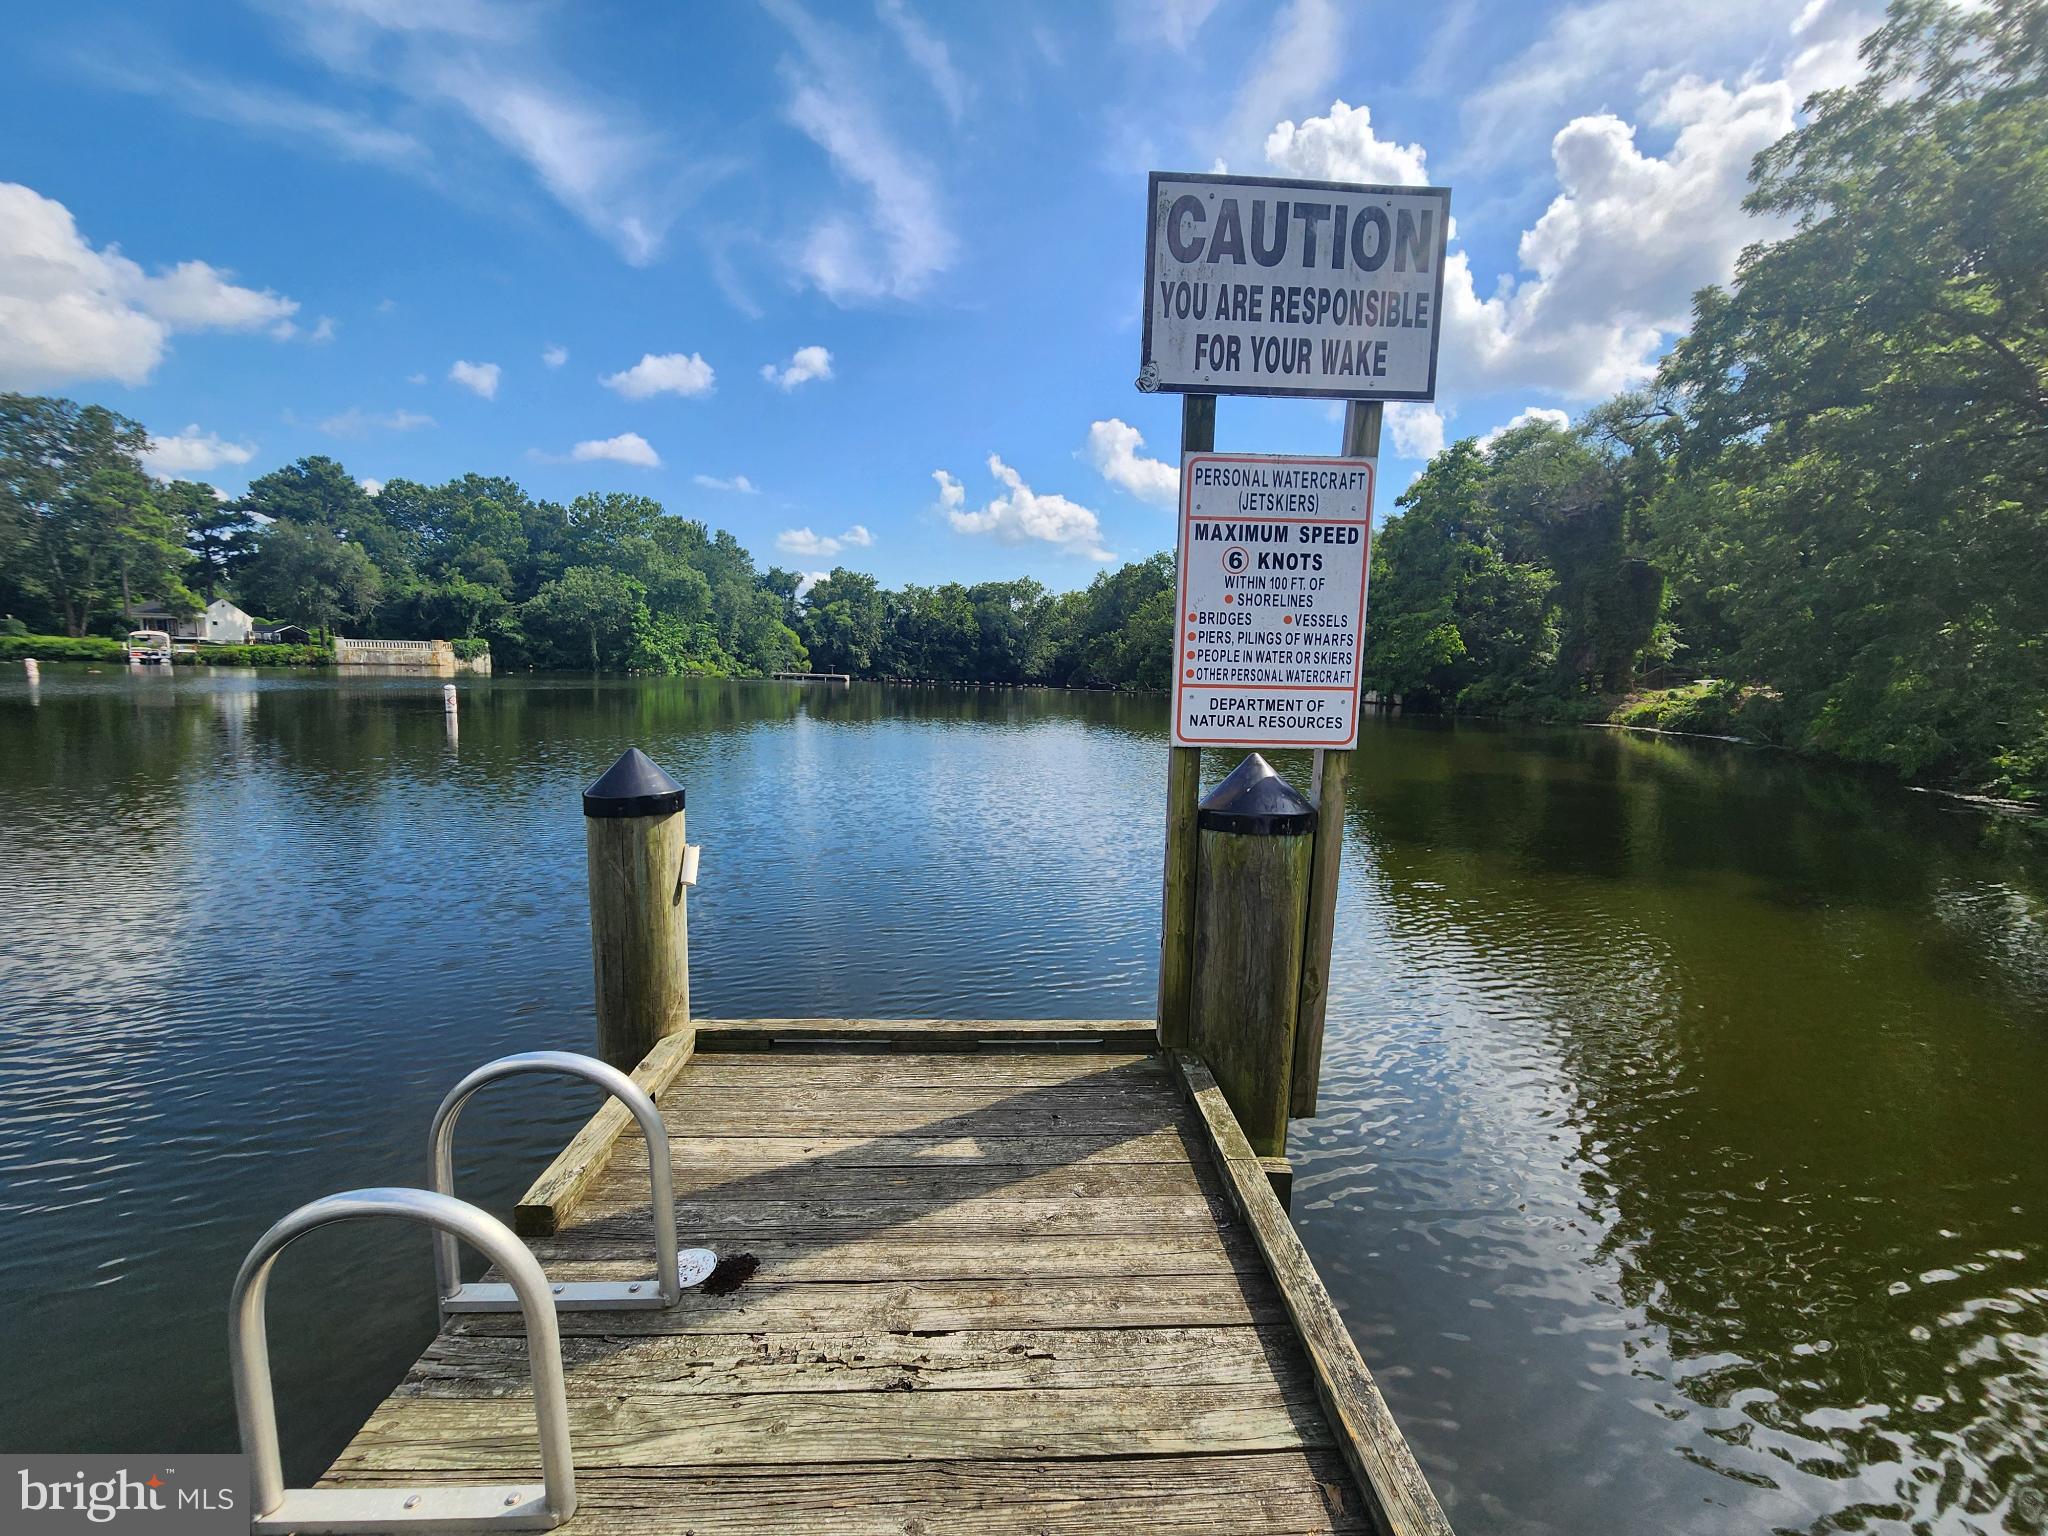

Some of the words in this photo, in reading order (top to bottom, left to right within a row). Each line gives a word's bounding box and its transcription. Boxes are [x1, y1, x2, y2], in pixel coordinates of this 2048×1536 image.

[1167, 195, 1433, 273] CAUTION
[1161, 281, 1208, 320] YOU
[1215, 284, 1263, 322] ARE
[1270, 286, 1429, 328] RESPONSIBLE
[1195, 334, 1241, 372] FOR
[1251, 336, 1312, 374] YOUR
[1321, 339, 1388, 376] WAKE
[1195, 468, 1269, 487] PERSONAL
[1273, 470, 1365, 490] WATERCRAFT
[1238, 491, 1319, 515] (JETSKIERS)
[1194, 523, 1288, 543] MAXIMUM
[1299, 525, 1359, 545] SPEED
[1228, 551, 1243, 570] 6
[1257, 552, 1323, 571] KNOTS
[1224, 575, 1266, 590] WITHIN
[1269, 576, 1288, 590] 100
[1290, 577, 1306, 591] FT.
[1309, 577, 1325, 591] OF
[1237, 593, 1313, 608] SHORELINES
[1198, 612, 1252, 626] BRIDGES
[1295, 613, 1348, 628] VESSELS
[1198, 630, 1234, 646] PIERS,
[1237, 631, 1282, 646] PILINGS
[1285, 632, 1300, 646] OF
[1303, 633, 1354, 647] WHARFS
[1197, 649, 1240, 663] PEOPLE
[1242, 650, 1252, 663] IN
[1255, 650, 1293, 664] WATER
[1295, 651, 1311, 664] OR
[1313, 651, 1352, 665] SKIERS
[1196, 667, 1229, 681] OTHER
[1231, 668, 1283, 682] PERSONAL
[1285, 669, 1352, 684] WATERCRAFT
[1209, 698, 1304, 712] DEPARTMENT
[1306, 699, 1325, 712] OF
[1189, 715, 1254, 728] NATURAL
[1258, 716, 1343, 729] RESOURCES
